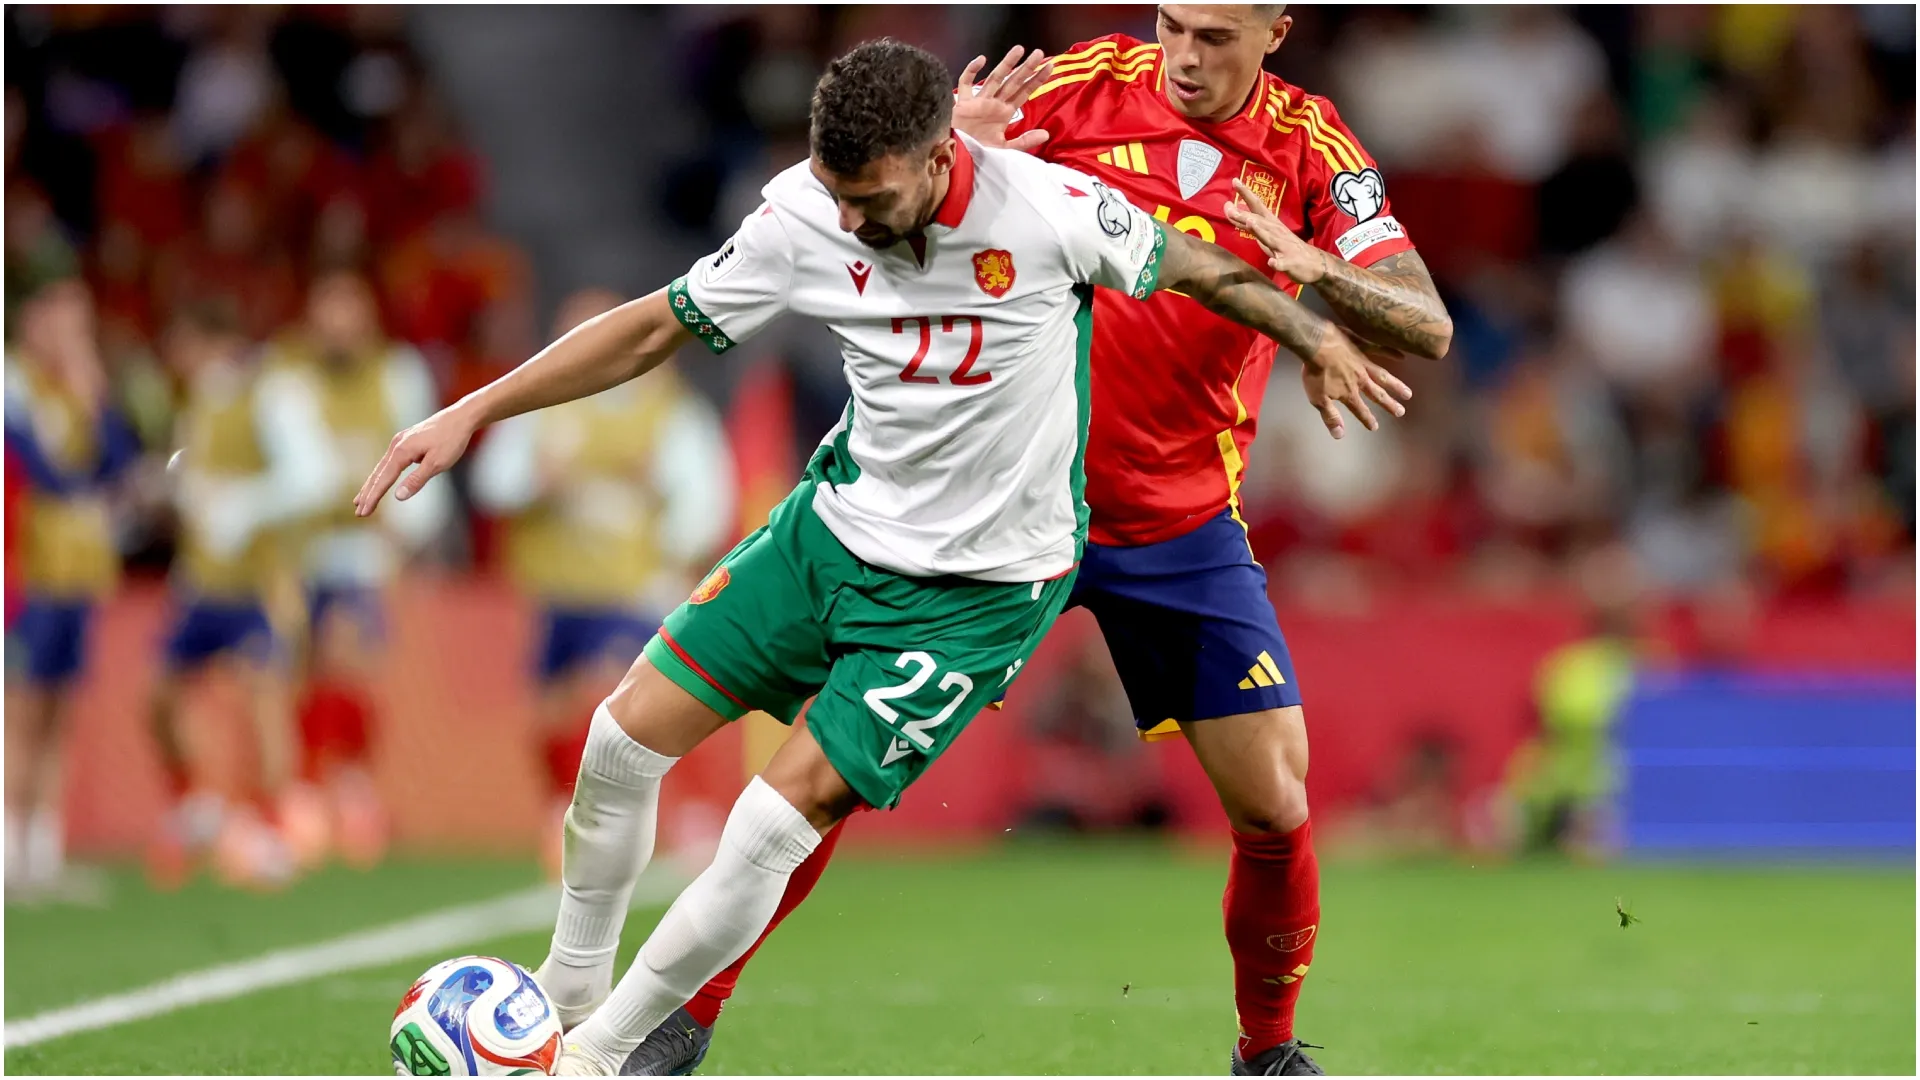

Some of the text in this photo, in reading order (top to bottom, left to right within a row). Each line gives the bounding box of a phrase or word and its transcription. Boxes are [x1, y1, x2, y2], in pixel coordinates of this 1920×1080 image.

[1340, 227, 1384, 252] FOUNDATION
[890, 315, 992, 386] 22
[863, 651, 974, 749] 22
